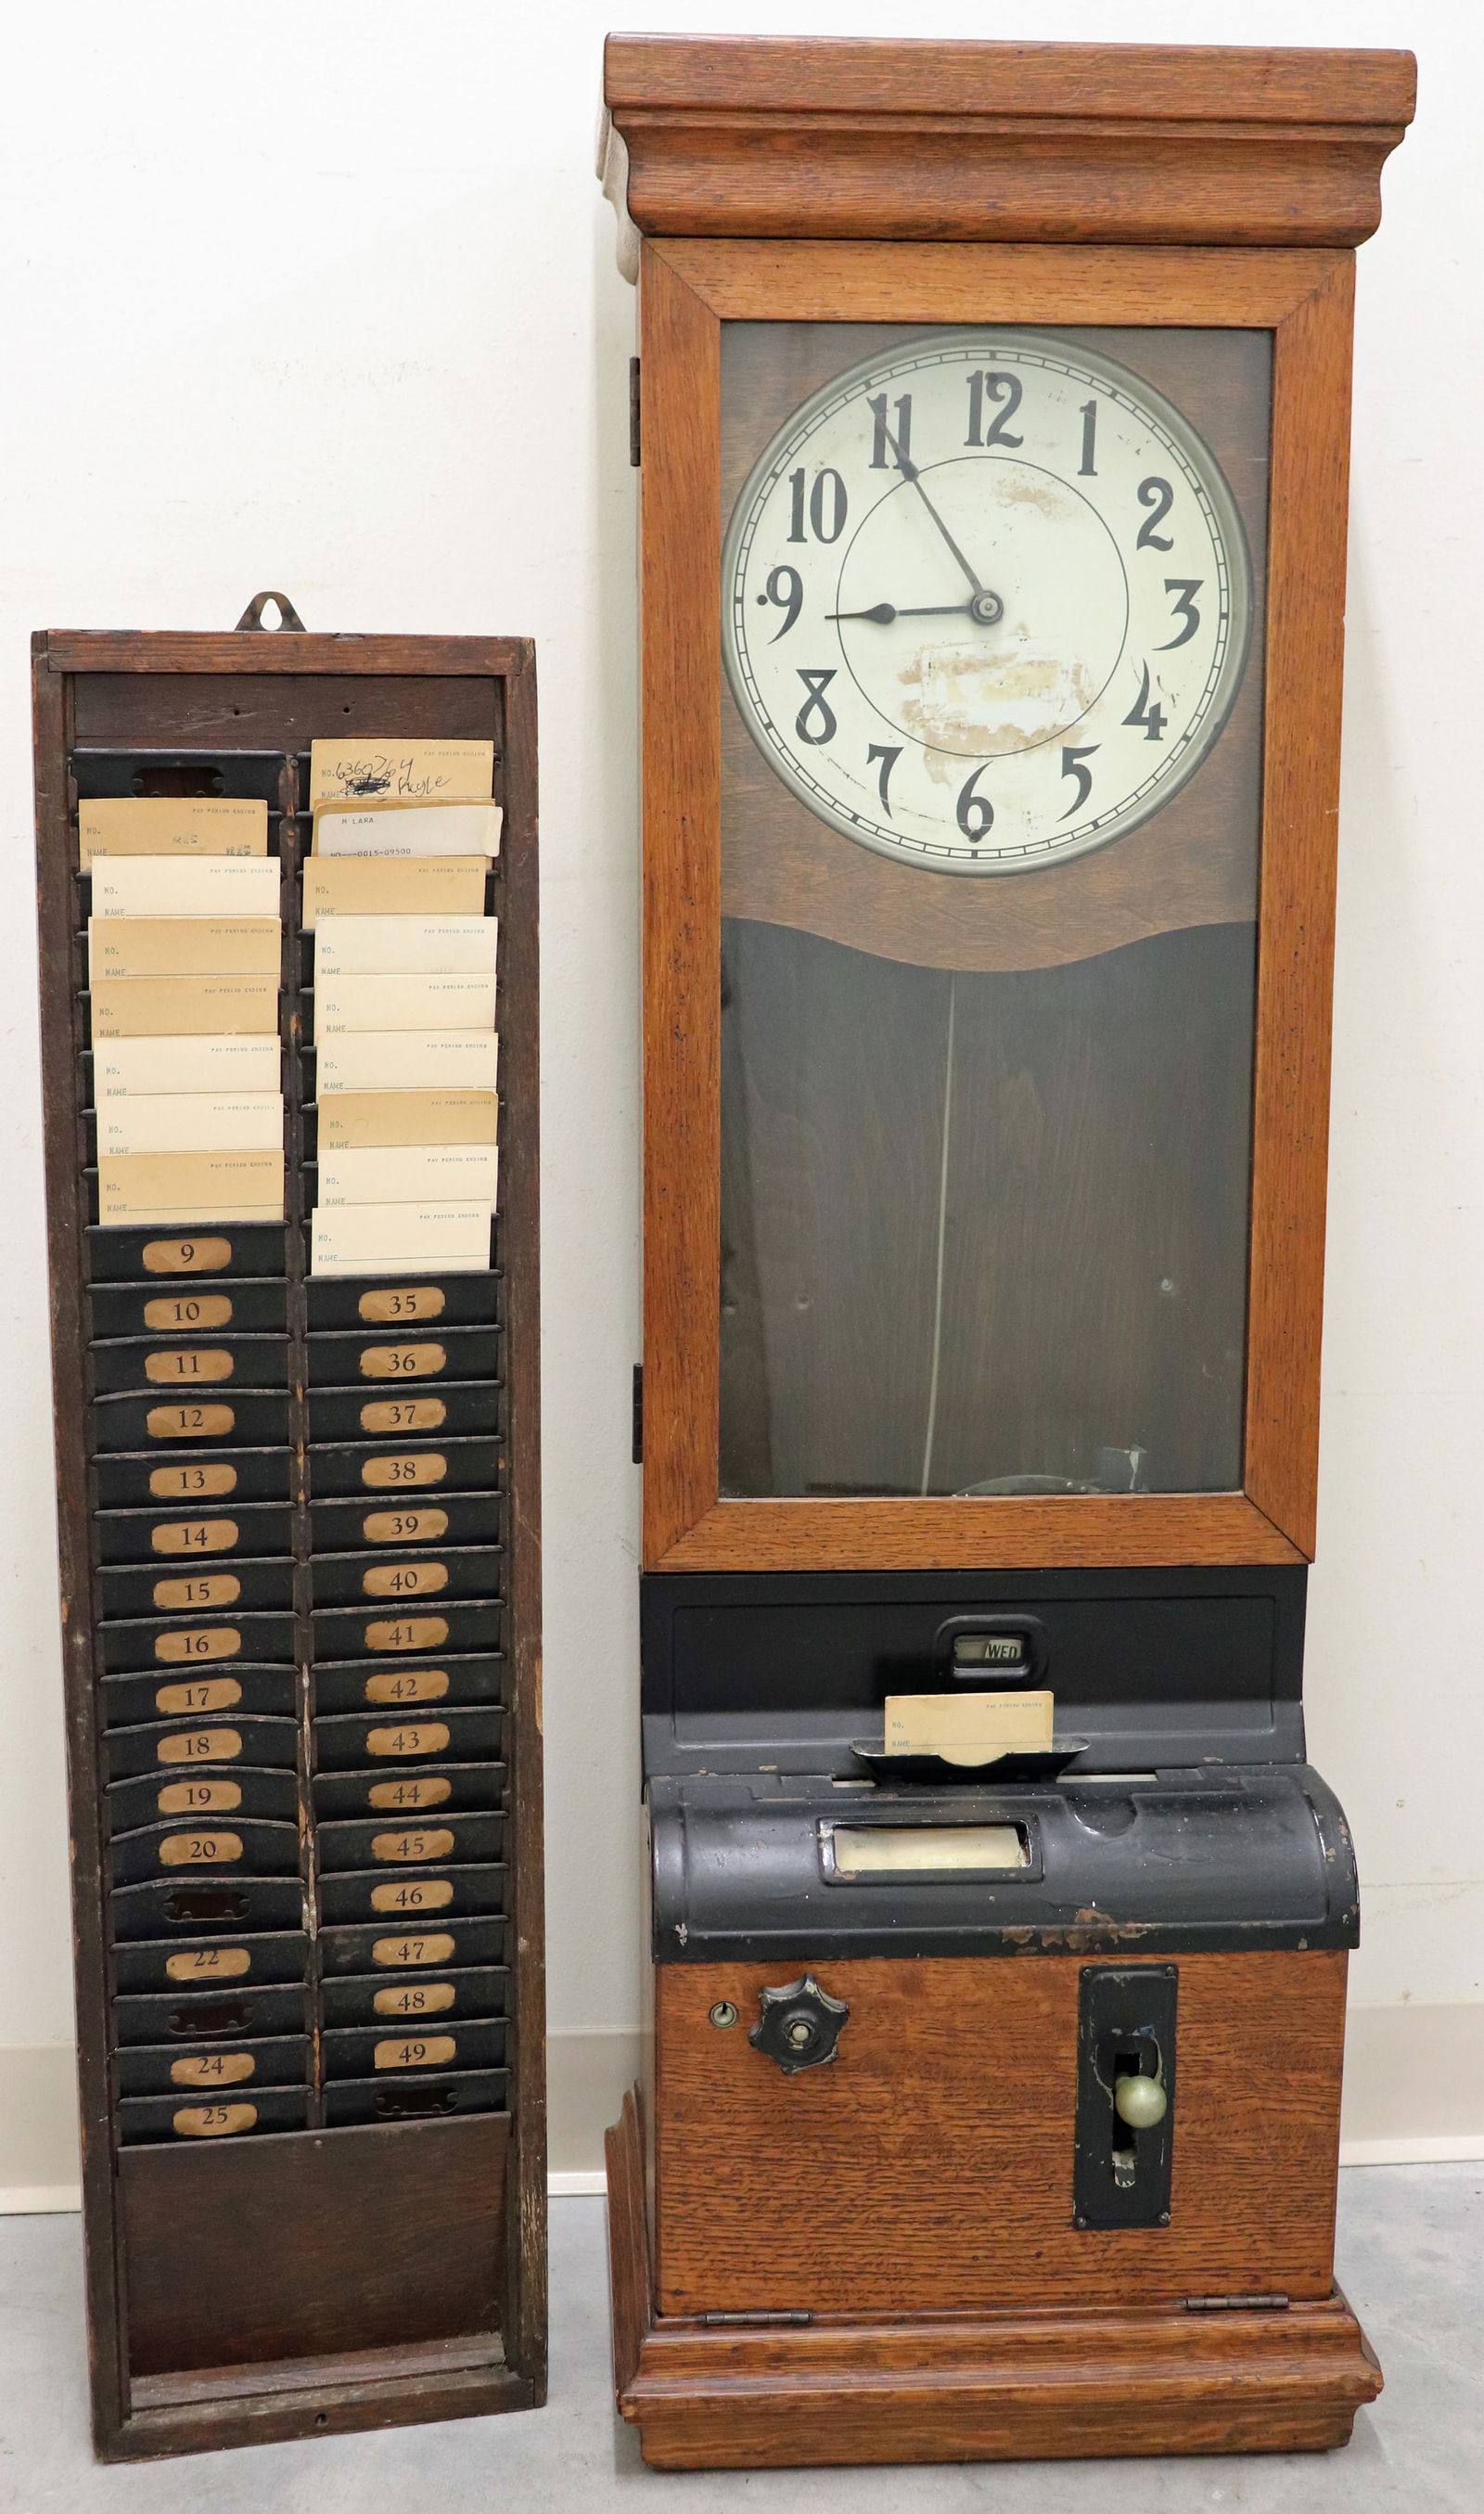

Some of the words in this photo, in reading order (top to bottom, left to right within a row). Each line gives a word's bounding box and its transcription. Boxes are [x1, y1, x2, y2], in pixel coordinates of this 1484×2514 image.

[964, 371, 1024, 447] 12
[868, 393, 912, 469] 11
[1078, 400, 1097, 475] 1
[787, 468, 848, 544] 10
[1136, 476, 1174, 551] 2
[766, 565, 803, 645] 9
[1152, 579, 1204, 650] 3
[796, 669, 837, 745] 8
[1121, 660, 1167, 740] 4
[322, 769, 335, 777] NO.
[866, 744, 903, 819] 7
[1055, 744, 1102, 822] 5
[321, 789, 340, 799] NAME
[956, 762, 993, 839] 6
[87, 827, 100, 835] NO.
[87, 848, 108, 856] NAME
[105, 908, 125, 917] NAME
[315, 907, 335, 916] NAME
[106, 968, 127, 977] NAME
[107, 1088, 126, 1097] NAME
[329, 1141, 349, 1149] NAME
[180, 1243, 195, 1263] 9
[173, 1302, 200, 1322] 10
[389, 1294, 416, 1315] 35
[176, 1354, 200, 1374] 11
[387, 1353, 416, 1372] 36
[178, 1409, 204, 1429] 12
[389, 1405, 416, 1425] 37
[180, 1469, 205, 1489] 13
[388, 1461, 416, 1481] 38
[390, 1516, 419, 1535] 39
[182, 1527, 208, 1546] 14
[185, 1582, 211, 1601] 15
[389, 1571, 418, 1592] 40
[184, 1635, 210, 1654] 16
[388, 1625, 415, 1646] 41
[988, 1644, 1017, 1658] WED
[185, 1687, 210, 1707] 17
[390, 1678, 418, 1700] 42
[185, 1737, 210, 1756] 18
[391, 1730, 420, 1751] 43
[186, 1788, 211, 1805] 19
[391, 1783, 421, 1803] 44
[190, 1841, 216, 1858] 20
[396, 1836, 424, 1856] 45
[394, 1887, 423, 1907] 46
[195, 1951, 219, 1967] 22
[397, 1942, 425, 1962] 47
[397, 1991, 426, 2011] 48
[399, 2043, 427, 2063] 49
[198, 2057, 224, 2074] 24
[202, 2106, 228, 2124] 25
